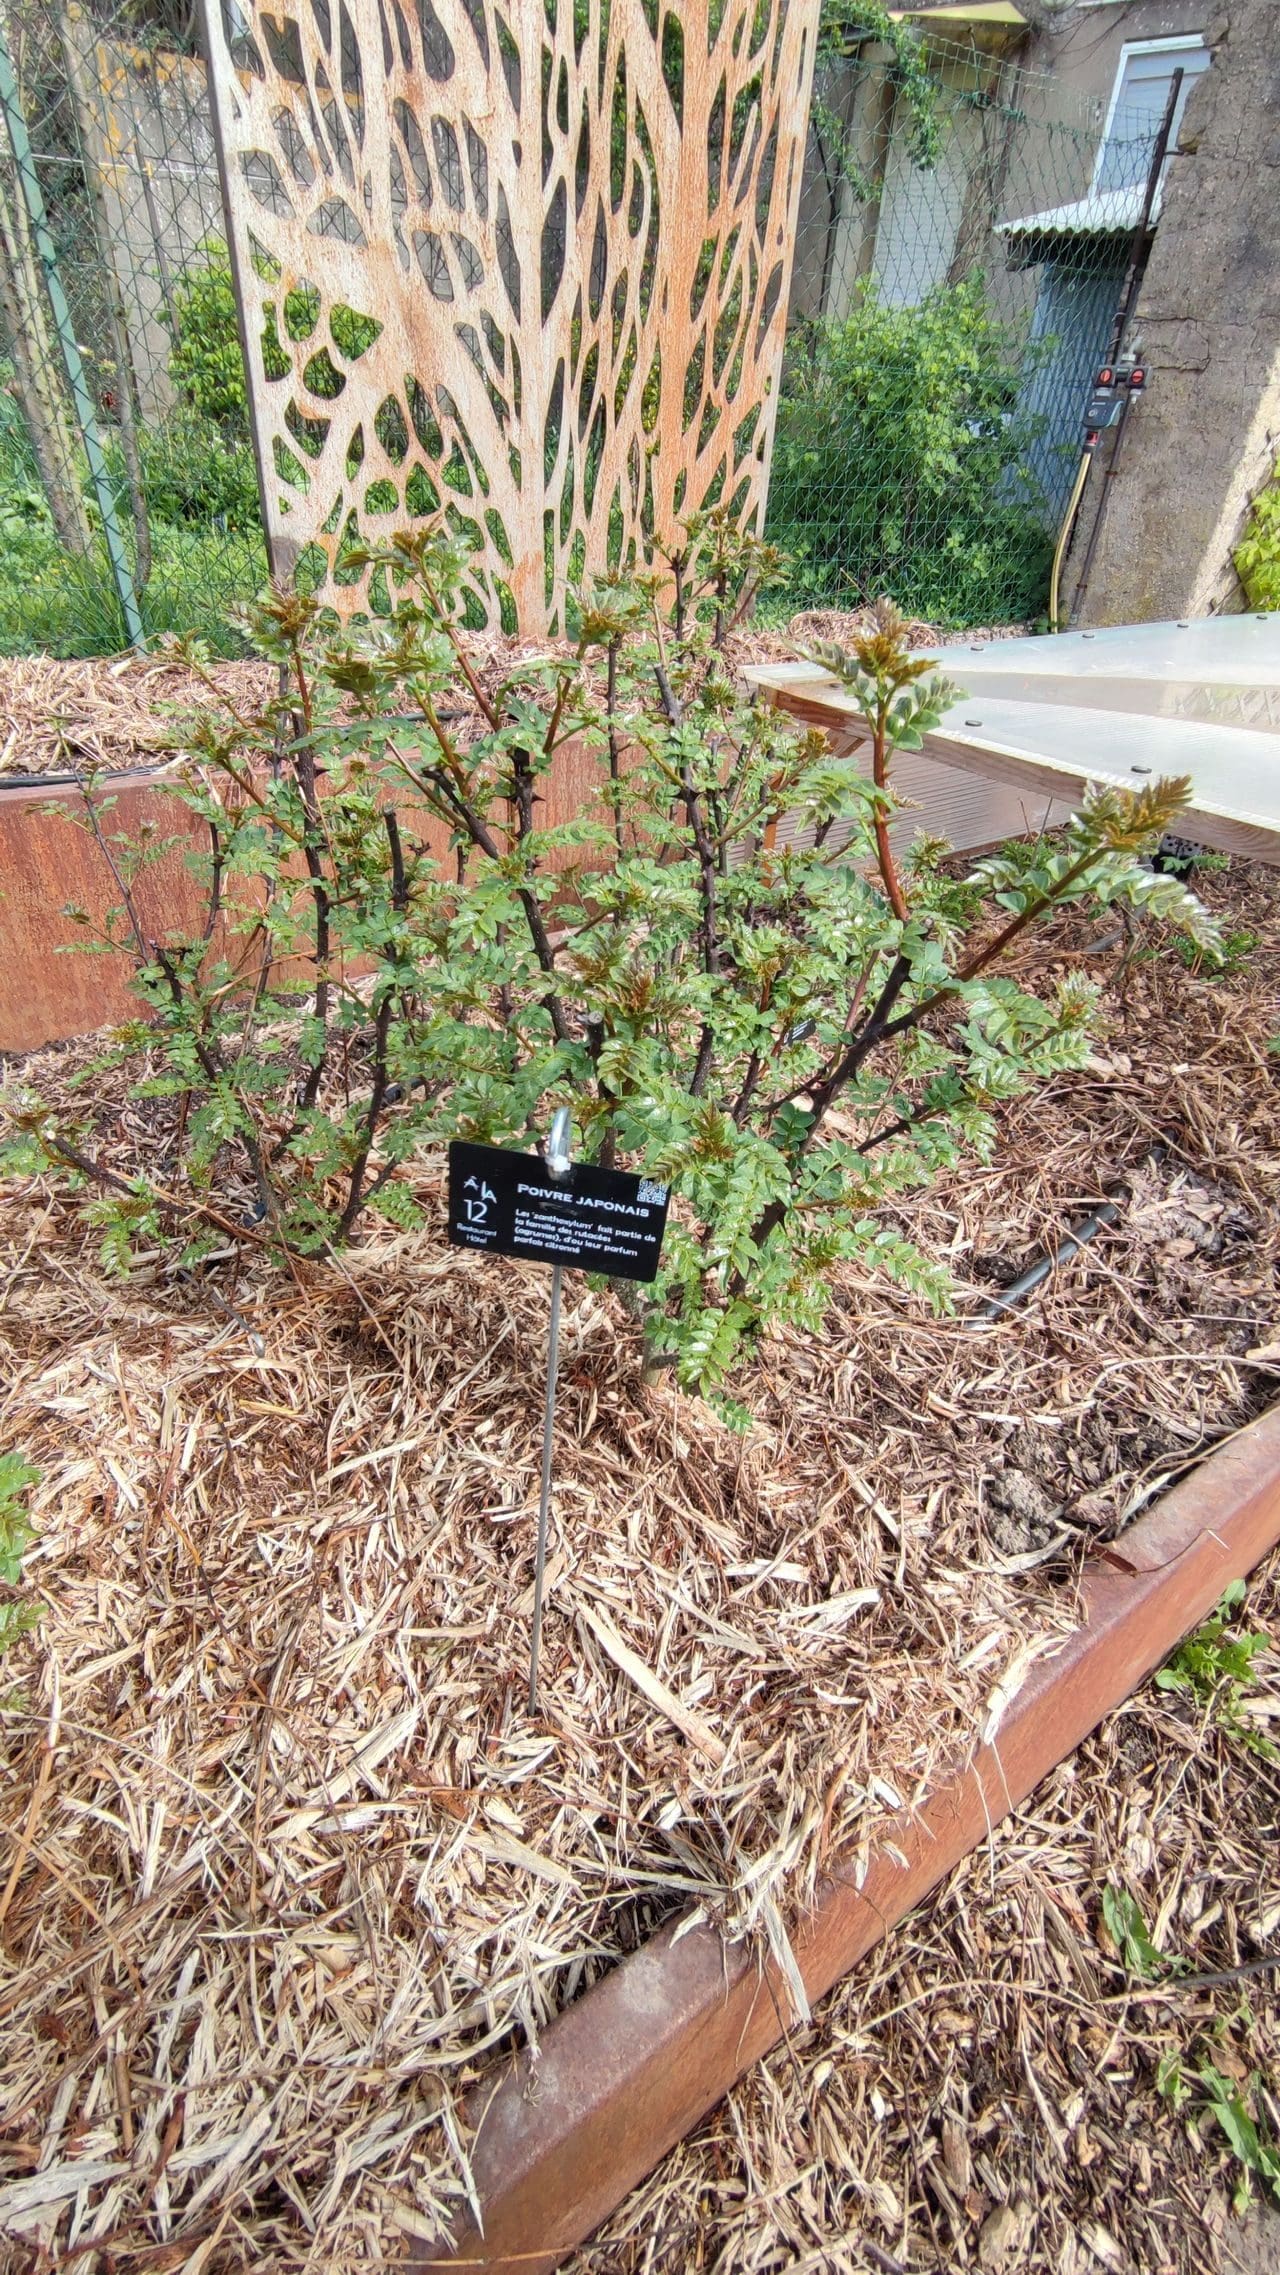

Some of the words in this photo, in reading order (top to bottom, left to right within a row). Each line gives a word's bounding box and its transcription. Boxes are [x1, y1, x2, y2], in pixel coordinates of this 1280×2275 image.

[517, 1183, 573, 1203] POIVRE
[576, 1196, 650, 1218] JAPONAIS
[463, 1199, 488, 1223] 12
[456, 1222, 497, 1237] Restaurant
[514, 1217, 525, 1226] la
[525, 1219, 556, 1232] famille
[557, 1226, 573, 1236] des
[598, 1224, 613, 1235] fait
[615, 1229, 642, 1240] partie
[644, 1233, 657, 1243] de
[513, 1235, 544, 1247] parfois
[544, 1242, 581, 1254] citronné
[584, 1239, 602, 1250] leur
[604, 1244, 638, 1257] parfum
